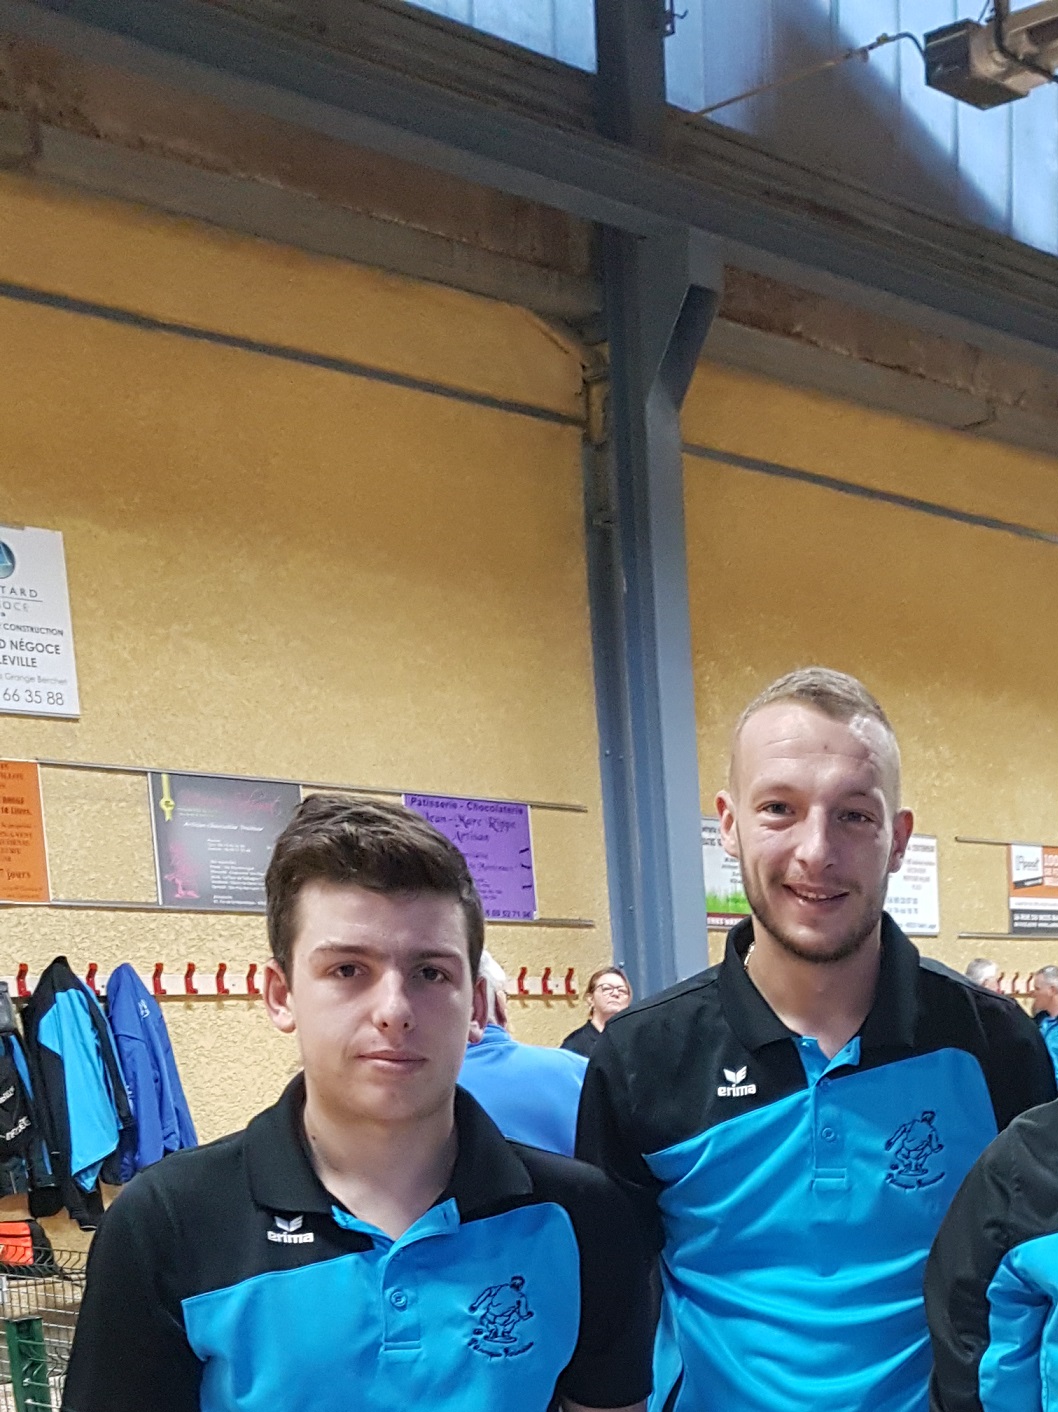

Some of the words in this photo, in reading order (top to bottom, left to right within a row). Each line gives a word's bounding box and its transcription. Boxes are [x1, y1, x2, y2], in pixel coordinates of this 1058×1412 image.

[0, 600, 29, 613] OCE
[3, 623, 64, 637] CONSTRUCTION
[9, 638, 61, 655] NÉGOCE
[0, 655, 38, 668] EVILLE
[2, 687, 20, 702] 66
[24, 689, 42, 704] 35
[46, 691, 64, 706] 88
[466, 801, 524, 815] Chocolaterie
[717, 1083, 757, 1097] erima
[266, 1230, 315, 1244] erima
